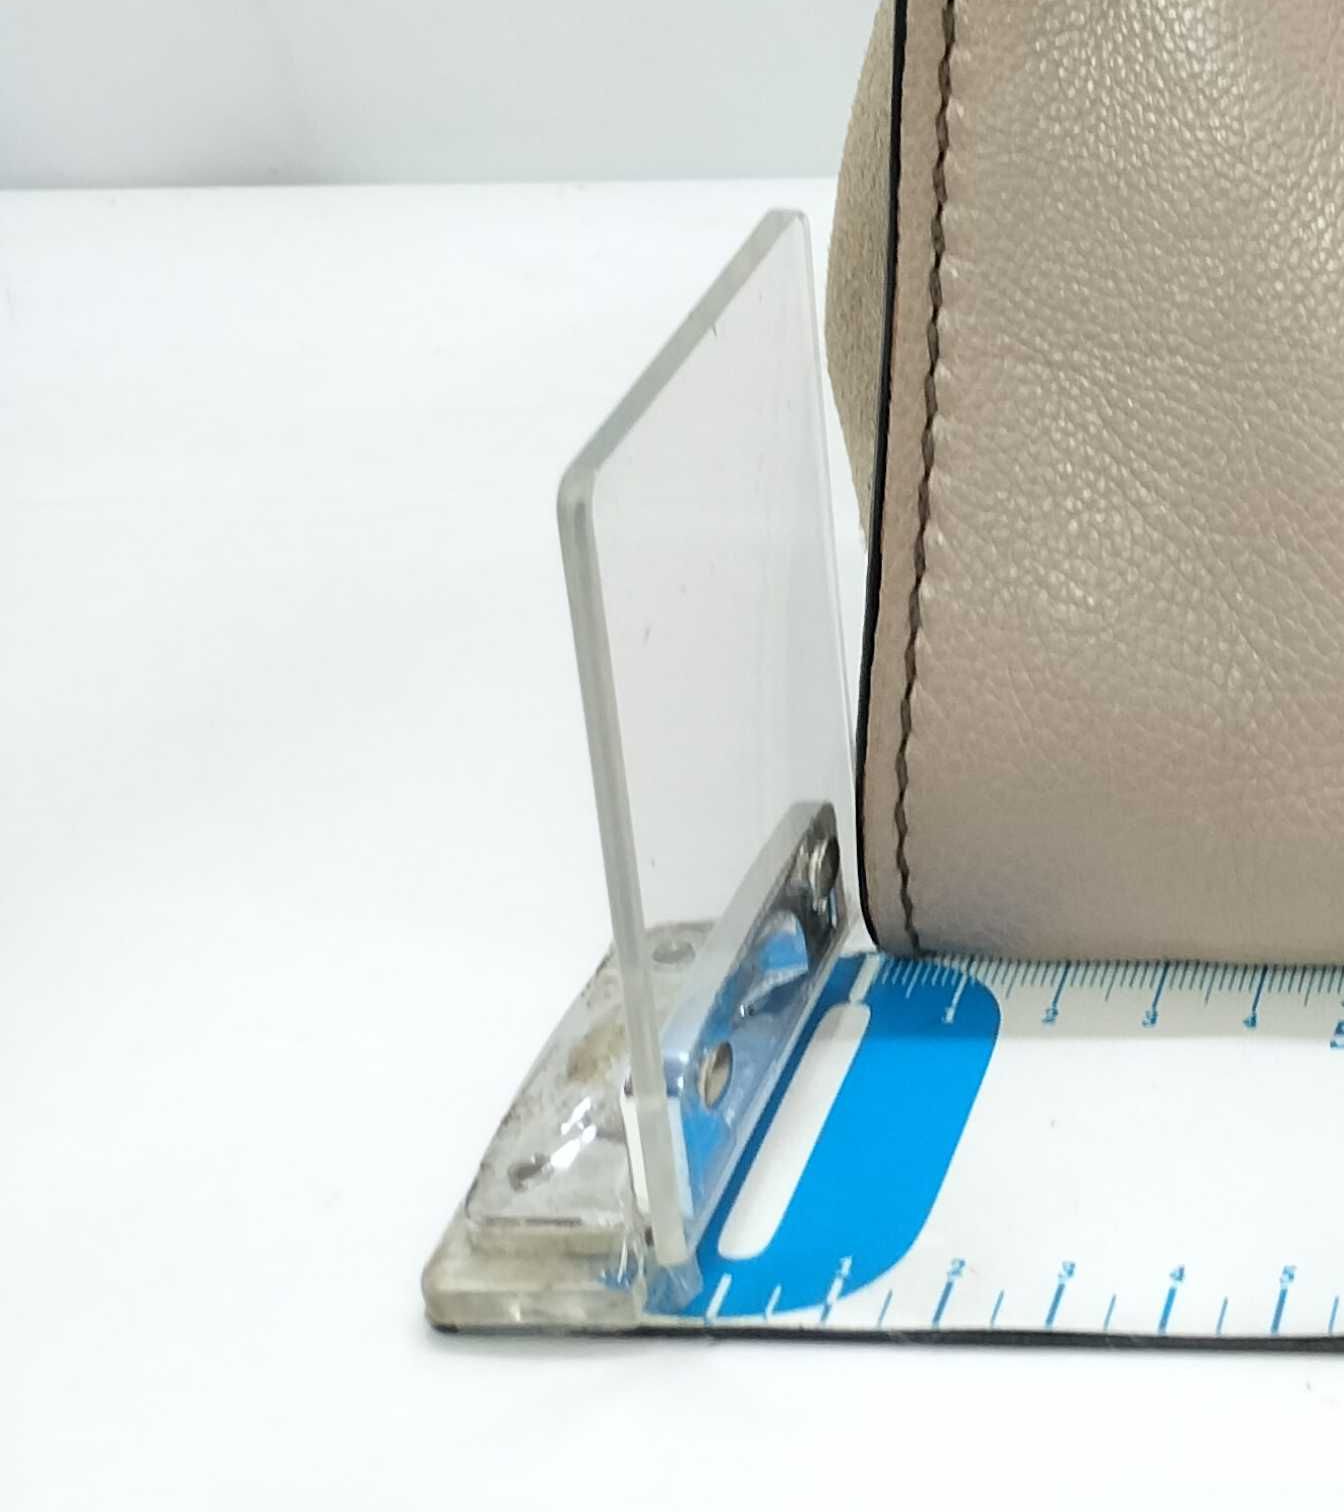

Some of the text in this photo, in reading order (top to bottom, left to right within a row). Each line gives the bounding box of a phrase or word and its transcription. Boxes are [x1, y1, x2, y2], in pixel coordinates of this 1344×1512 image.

[1042, 1007, 1058, 1026] 2
[838, 1257, 853, 1277] 1
[947, 1259, 964, 1279] 2
[1059, 1261, 1075, 1281] 3
[1170, 1264, 1186, 1284] 4
[1281, 1265, 1296, 1285] 5
